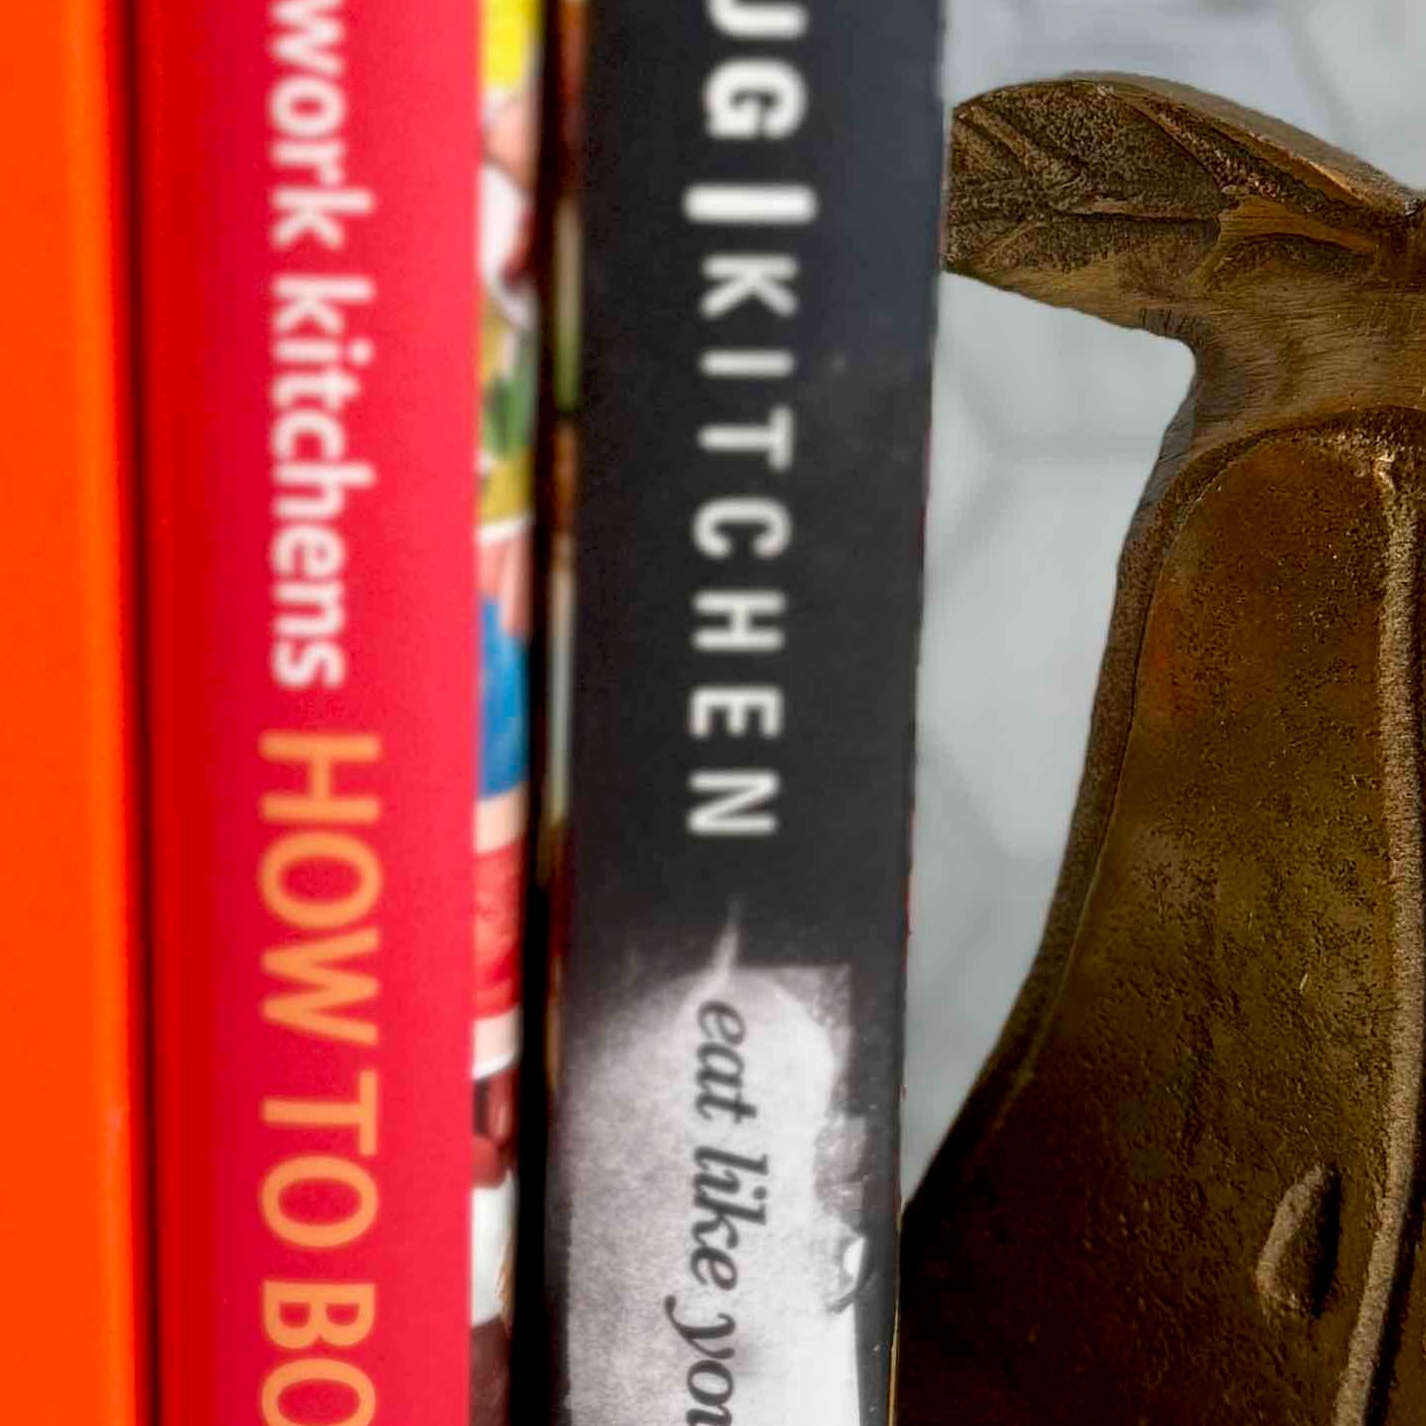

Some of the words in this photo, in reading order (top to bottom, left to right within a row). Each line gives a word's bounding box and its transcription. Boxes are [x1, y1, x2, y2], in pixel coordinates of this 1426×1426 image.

[272, 276, 374, 688] kitchens
[687, 254, 798, 837] KITCHEN
[259, 733, 383, 1045] HOW
[260, 1069, 380, 1250] TO
[695, 1000, 758, 1124] eat
[690, 1146, 768, 1291] like
